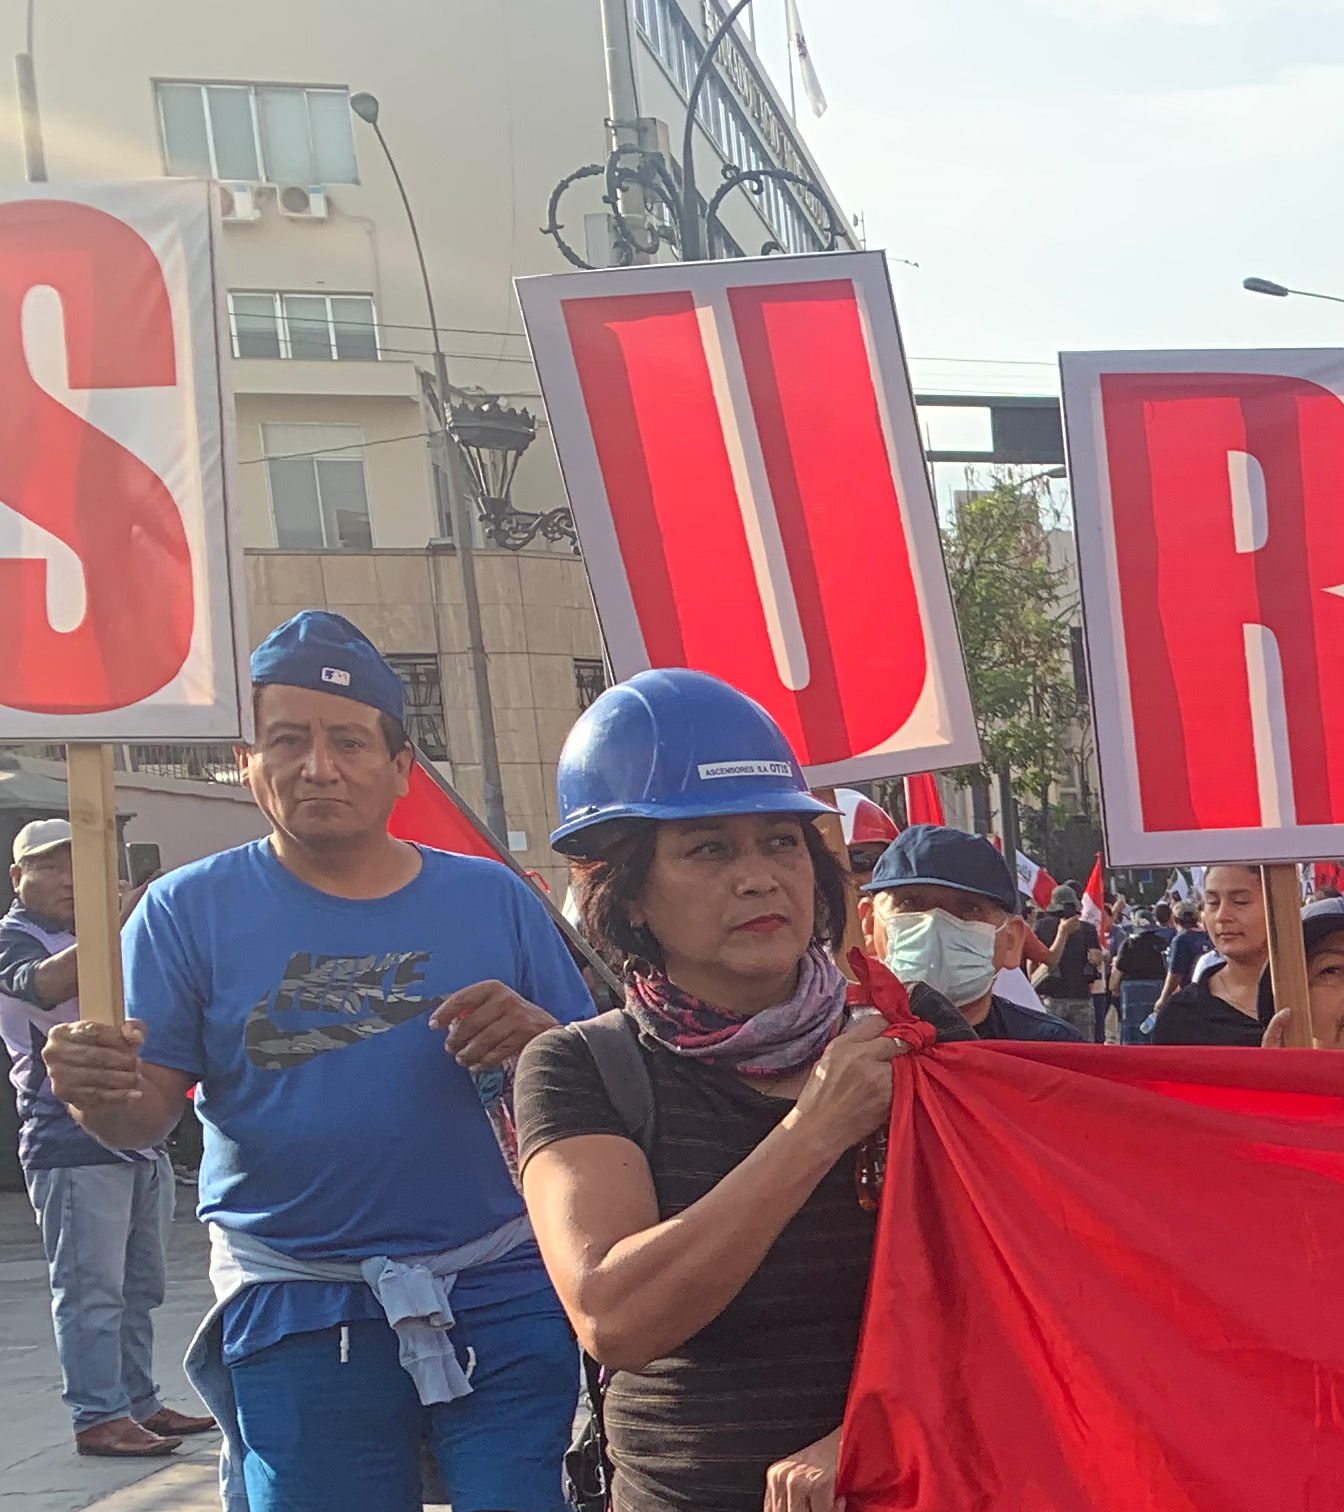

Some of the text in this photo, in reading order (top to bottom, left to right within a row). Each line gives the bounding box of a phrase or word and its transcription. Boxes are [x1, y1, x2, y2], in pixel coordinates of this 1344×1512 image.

[0, 200, 193, 714] S
[562, 280, 927, 766] U
[705, 766, 755, 776] ASCENSORES
[769, 763, 789, 774] OTIS
[272, 951, 433, 1014] NIKE
